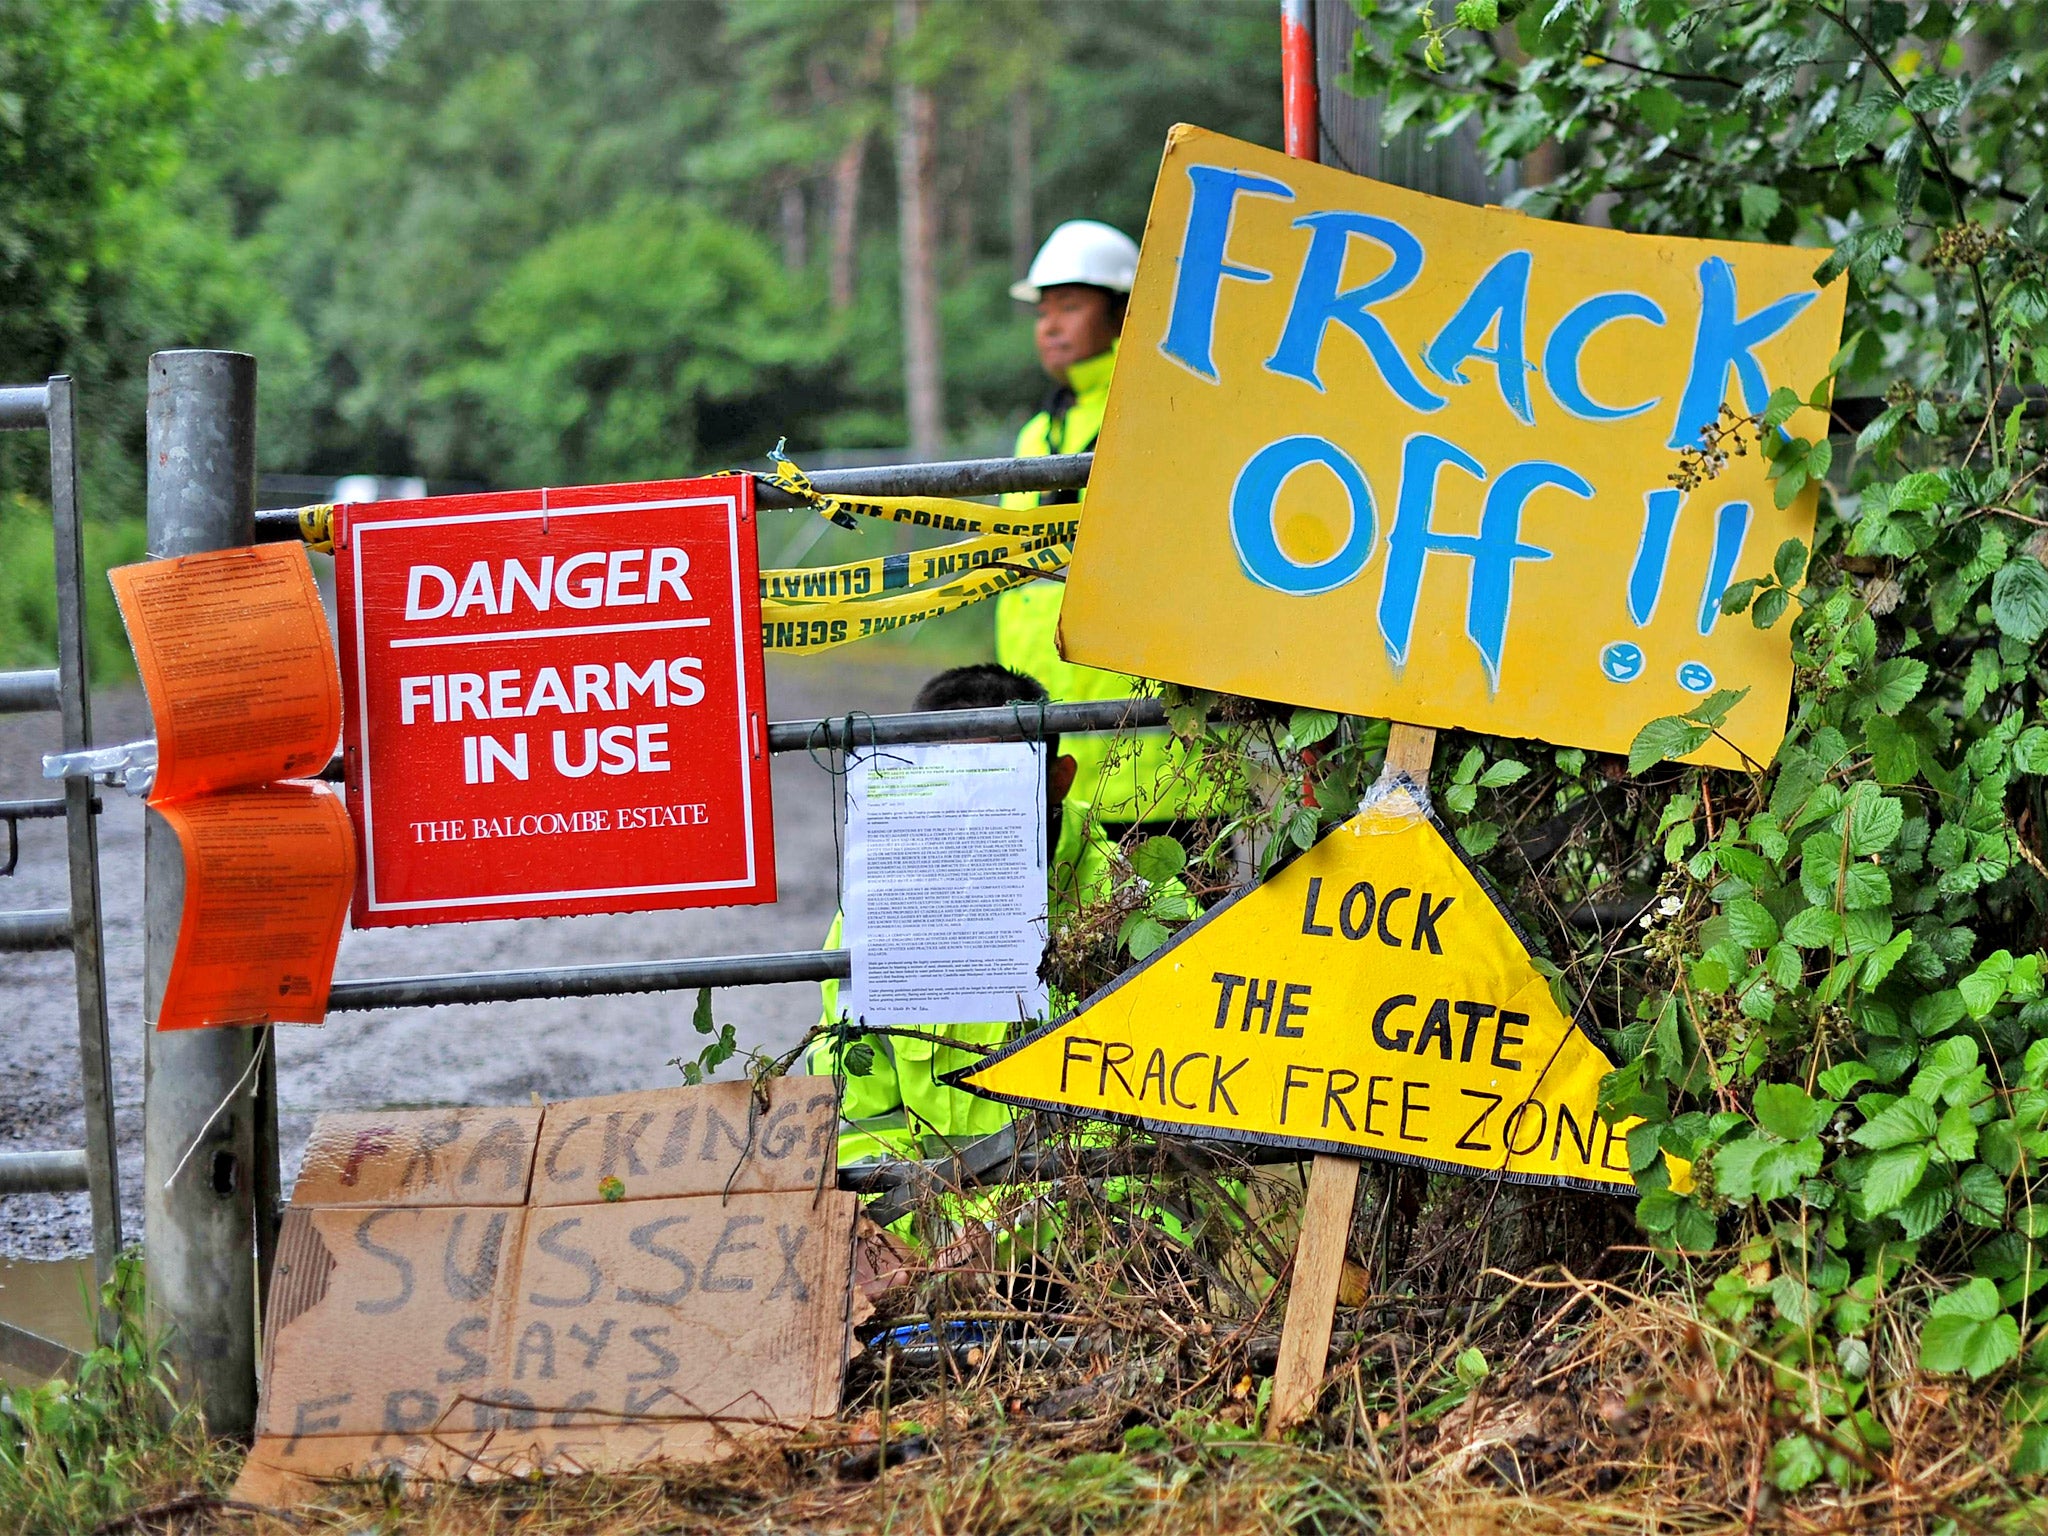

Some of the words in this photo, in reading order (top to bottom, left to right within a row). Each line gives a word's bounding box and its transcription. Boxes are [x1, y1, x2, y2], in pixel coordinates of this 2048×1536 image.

[1157, 163, 1822, 452] FRACK
[404, 547, 693, 621] DANGER
[1230, 432, 1599, 697] OFF
[763, 620, 847, 648] SCENE
[400, 657, 706, 725] FIREARMS
[463, 733, 529, 784] IN
[552, 722, 671, 779] USE
[410, 819, 467, 844] THE
[471, 809, 612, 839] BALCOMBE
[616, 803, 709, 829] ESTATE
[1302, 876, 1456, 956] LOCK
[1210, 972, 1312, 1039] THE
[1371, 994, 1531, 1072] GATE
[1059, 1036, 1250, 1116] FRACK
[1279, 1064, 1431, 1142] FREE
[339, 1092, 840, 1187] FRACKING?
[354, 1207, 810, 1315] SUSSEX
[436, 1317, 681, 1385] SAYS
